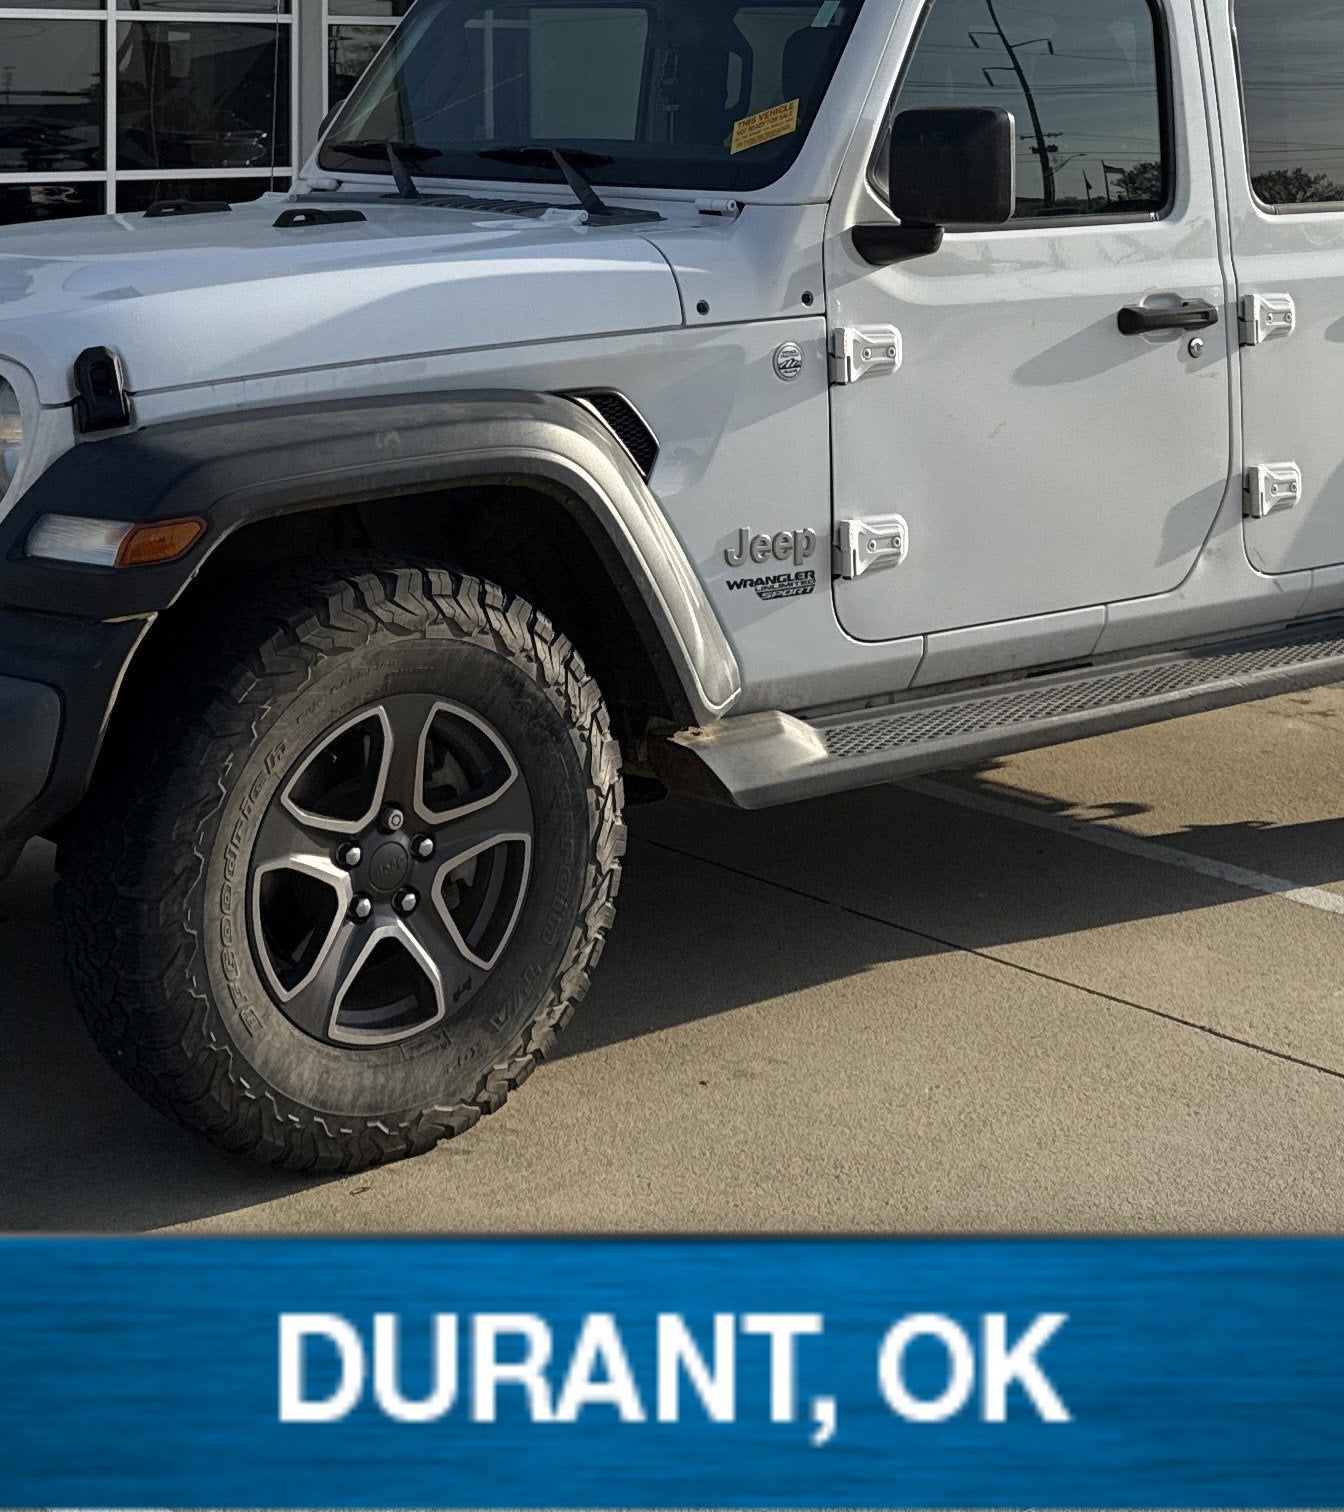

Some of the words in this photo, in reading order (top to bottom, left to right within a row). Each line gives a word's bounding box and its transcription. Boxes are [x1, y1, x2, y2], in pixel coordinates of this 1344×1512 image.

[723, 526, 817, 567] Jeep
[725, 569, 816, 591] WRANGLER
[759, 586, 815, 600] SPORT
